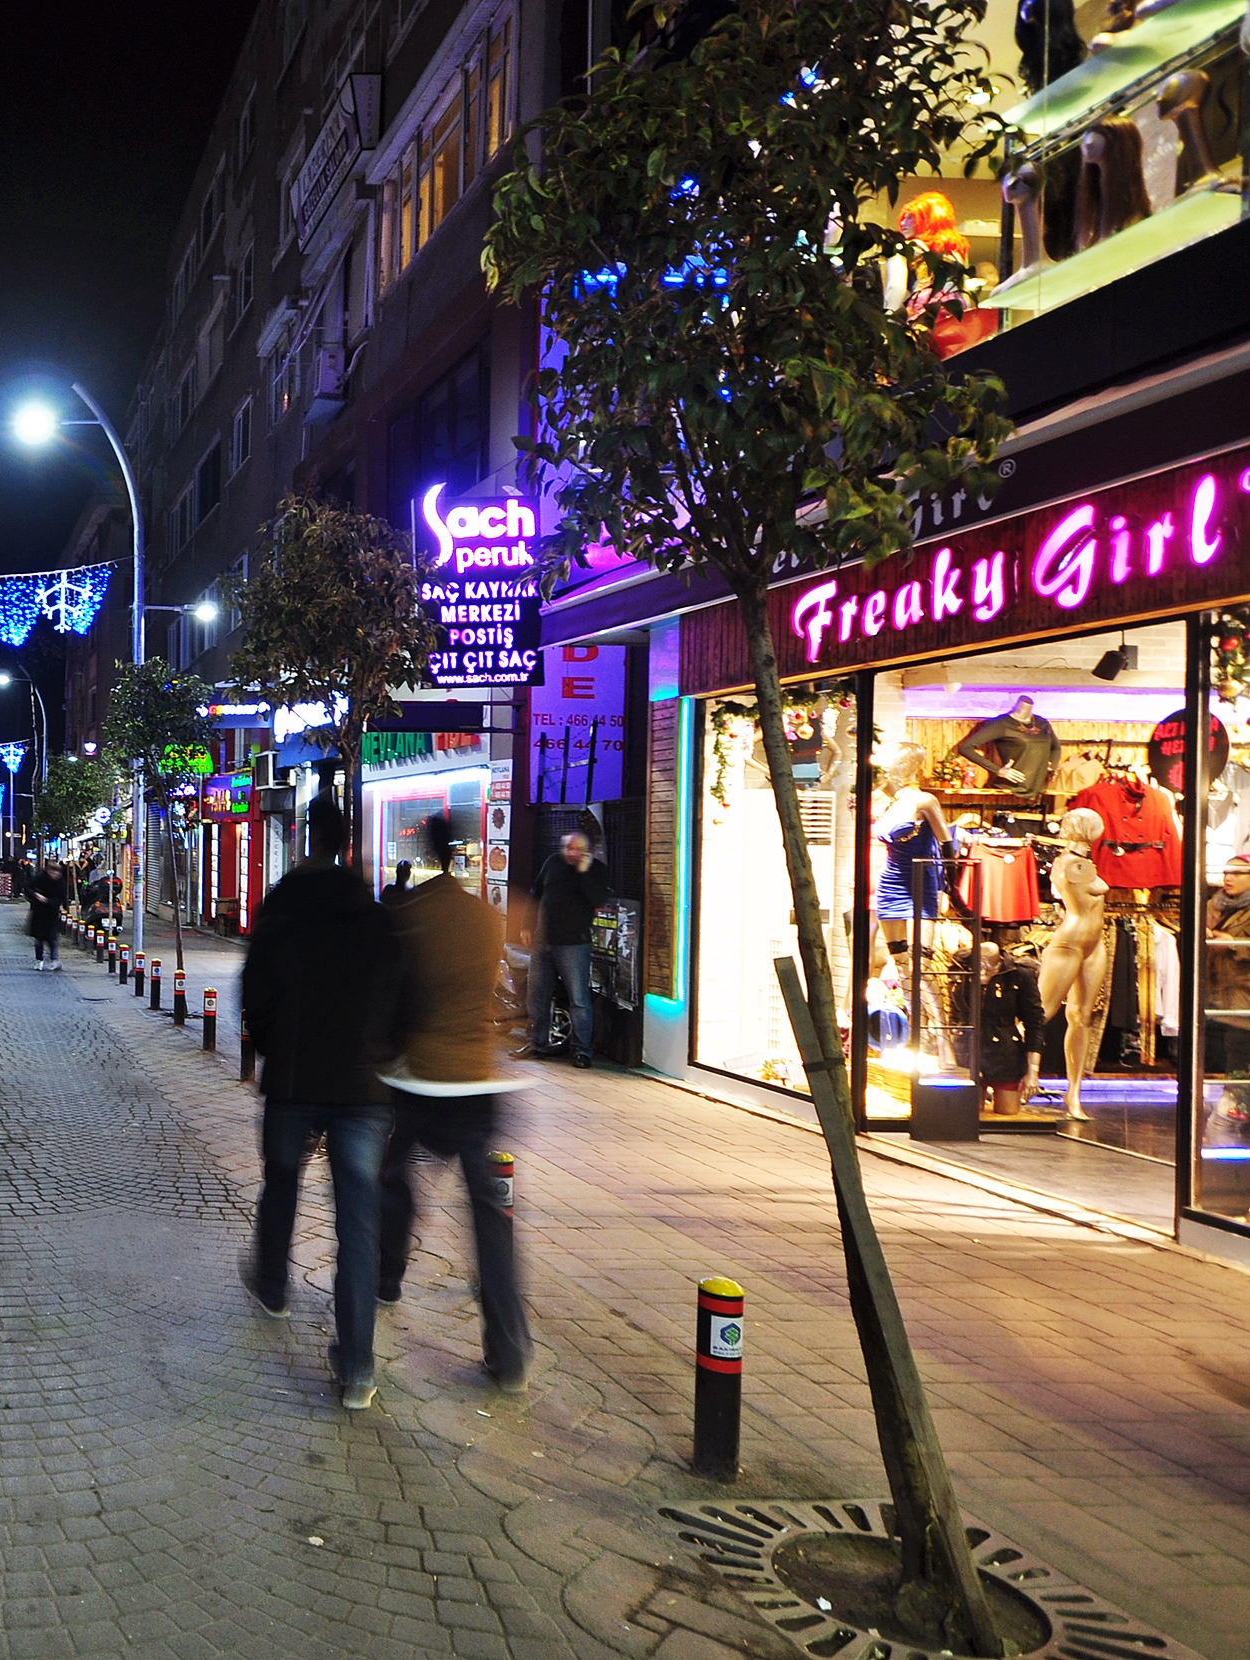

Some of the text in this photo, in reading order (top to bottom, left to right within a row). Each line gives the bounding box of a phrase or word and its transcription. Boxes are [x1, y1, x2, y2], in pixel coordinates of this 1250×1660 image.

[423, 482, 536, 568] Sach
[455, 540, 535, 574] peruk
[792, 472, 1222, 662] Freaky Girl
[421, 581, 460, 603] SAÇ
[441, 600, 521, 623] MERKEZİ
[449, 624, 514, 649] POSTİŞ
[428, 650, 537, 674] ÇIT ÇIT SAÇ
[436, 673, 530, 685] www.sach.com.tr
[533, 713, 555, 726] TEL
[567, 714, 588, 727] 466
[610, 715, 624, 728] 50
[602, 740, 624, 751] 70
